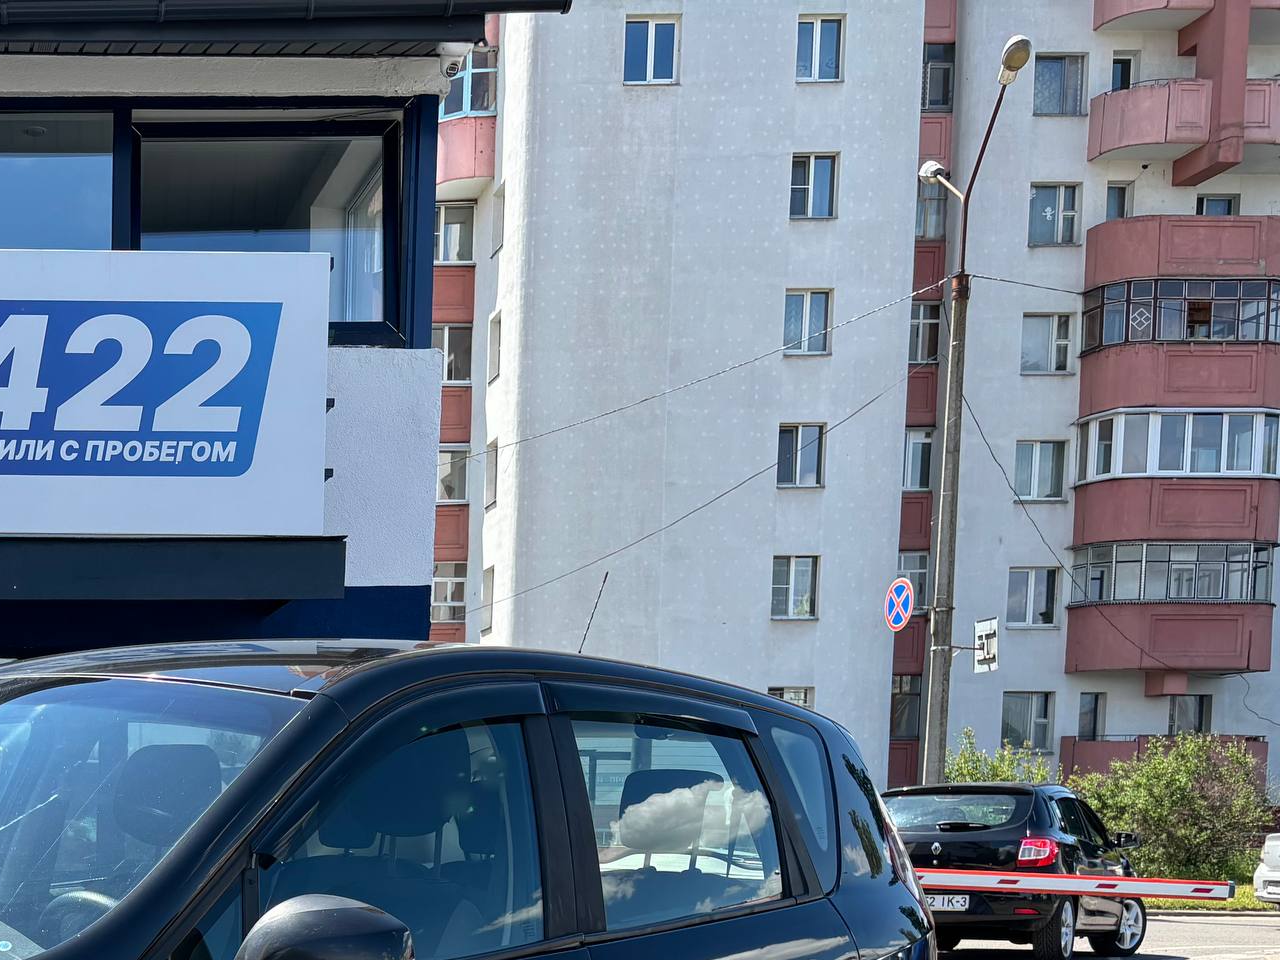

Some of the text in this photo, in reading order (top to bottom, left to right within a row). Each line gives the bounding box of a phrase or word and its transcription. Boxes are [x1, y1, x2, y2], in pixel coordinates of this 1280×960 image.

[60, 440, 80, 461] С
[84, 441, 237, 464] ПРОБЕГОМ
[926, 896, 967, 907] 2 IK-3
